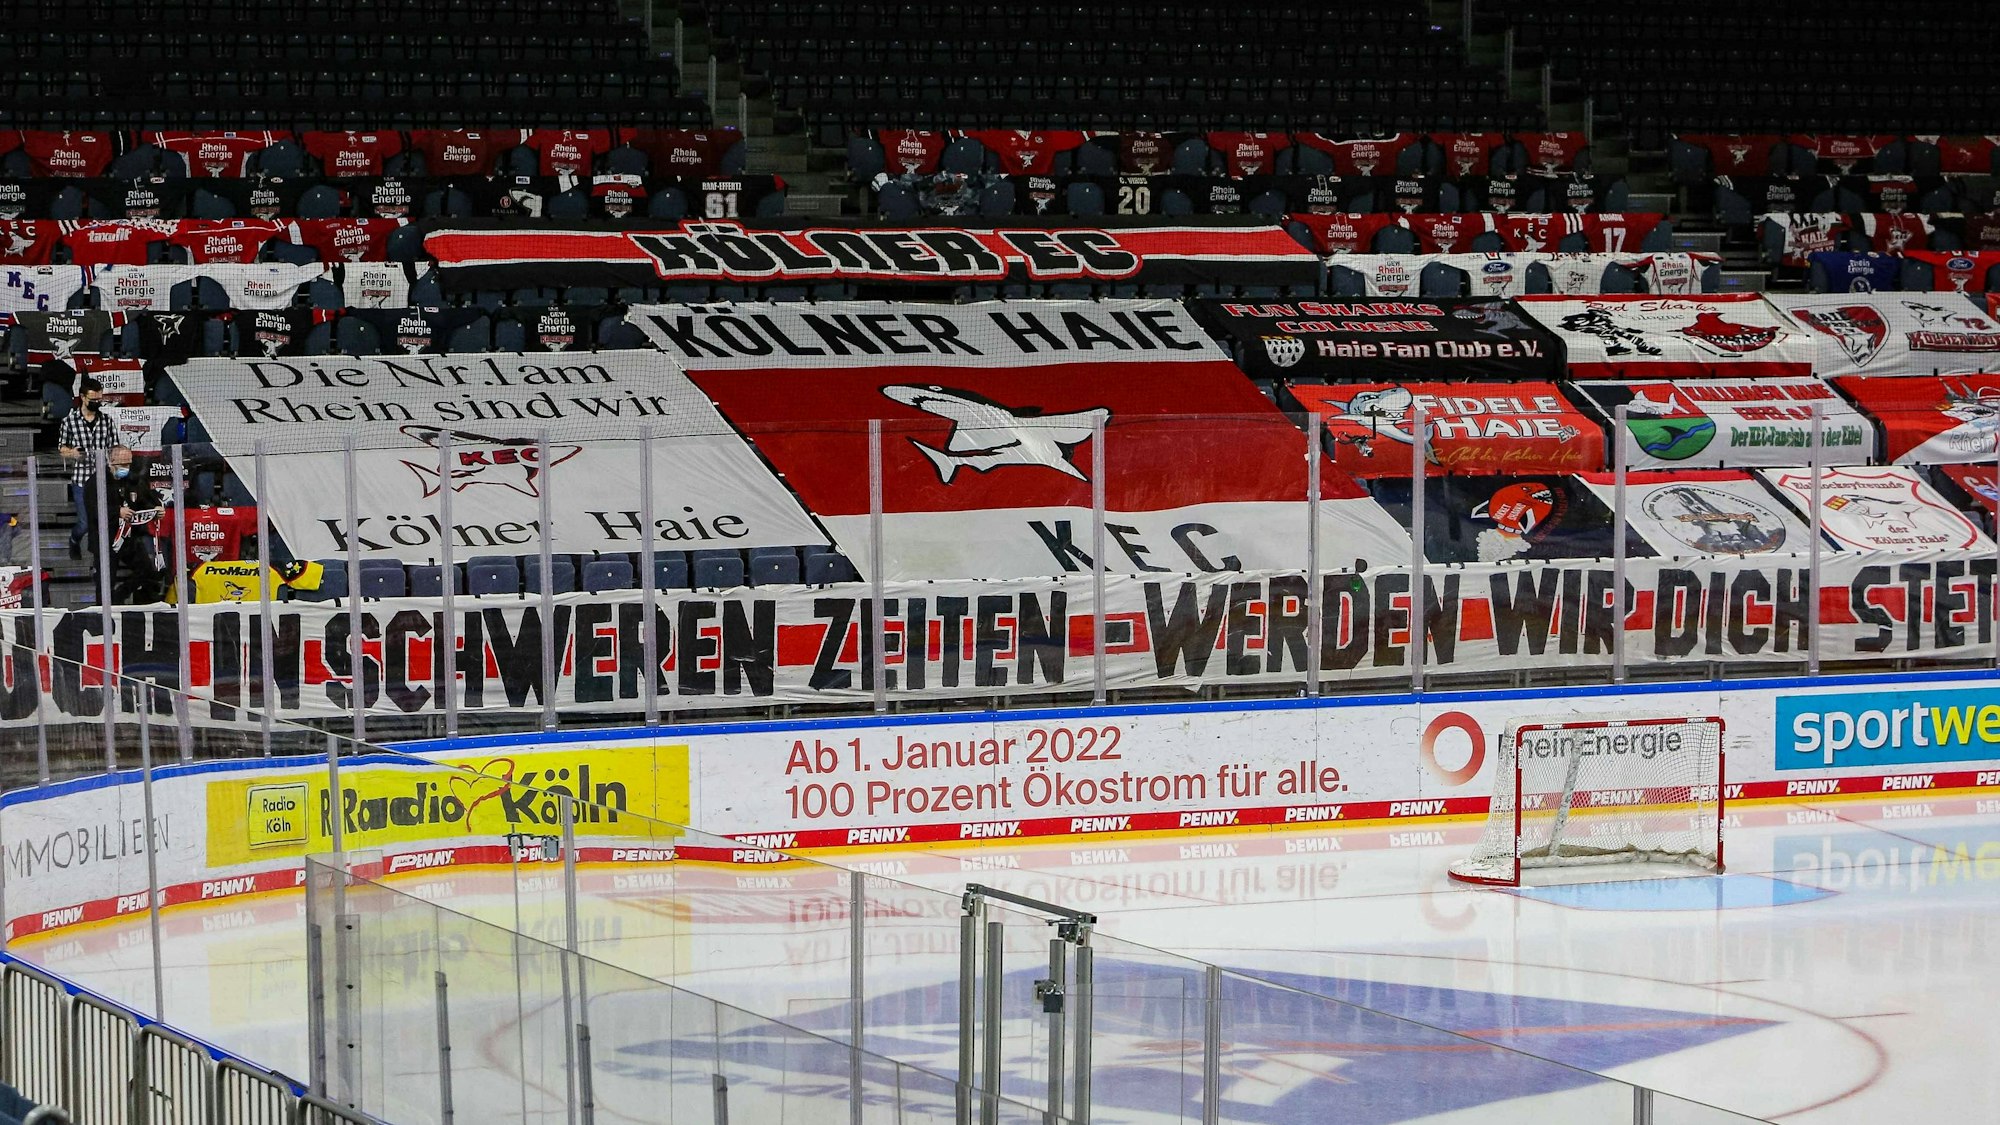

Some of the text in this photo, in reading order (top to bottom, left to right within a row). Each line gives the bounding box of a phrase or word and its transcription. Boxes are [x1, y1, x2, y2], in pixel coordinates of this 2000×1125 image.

[705, 192, 739, 218] 61
[1118, 186, 1150, 214] 20
[632, 225, 1140, 277] KÖLNER EC
[114, 286, 155, 296] Energie
[118, 278, 148, 286] Rhein
[361, 279, 391, 287] Energie
[1222, 302, 1445, 317] FUN SHARKS
[648, 302, 1204, 358] KÖLNER HAIE
[1277, 320, 1438, 333] COLOGNE
[1316, 340, 1379, 358] Haie
[1380, 341, 1430, 358] Fan
[1436, 340, 1493, 358] Club
[247, 361, 370, 388] Die
[232, 390, 674, 424] Rhein sind wir
[1411, 394, 1563, 414] FIDELE
[1434, 416, 1562, 439] HAIE
[460, 445, 539, 465] KEC
[1791, 481, 1904, 490] Eisockeyfreunde
[190, 530, 225, 541] Energie
[193, 522, 219, 532] Rhein
[318, 506, 750, 552] Kölner Haie
[1888, 525, 1909, 533] der
[210, 612, 300, 721] IN
[324, 600, 776, 712] SCHWEREN
[808, 590, 1067, 690] ZEITEN
[1144, 574, 1461, 678] WERDEN
[1490, 567, 1635, 655] WIR
[1655, 567, 1810, 656] DICH
[785, 726, 1122, 776] Ab 1. Januar 2022
[785, 760, 1348, 819] 100 Prozent Ökostrom für alle.
[263, 798, 295, 813] Radio
[266, 816, 291, 833] Köln
